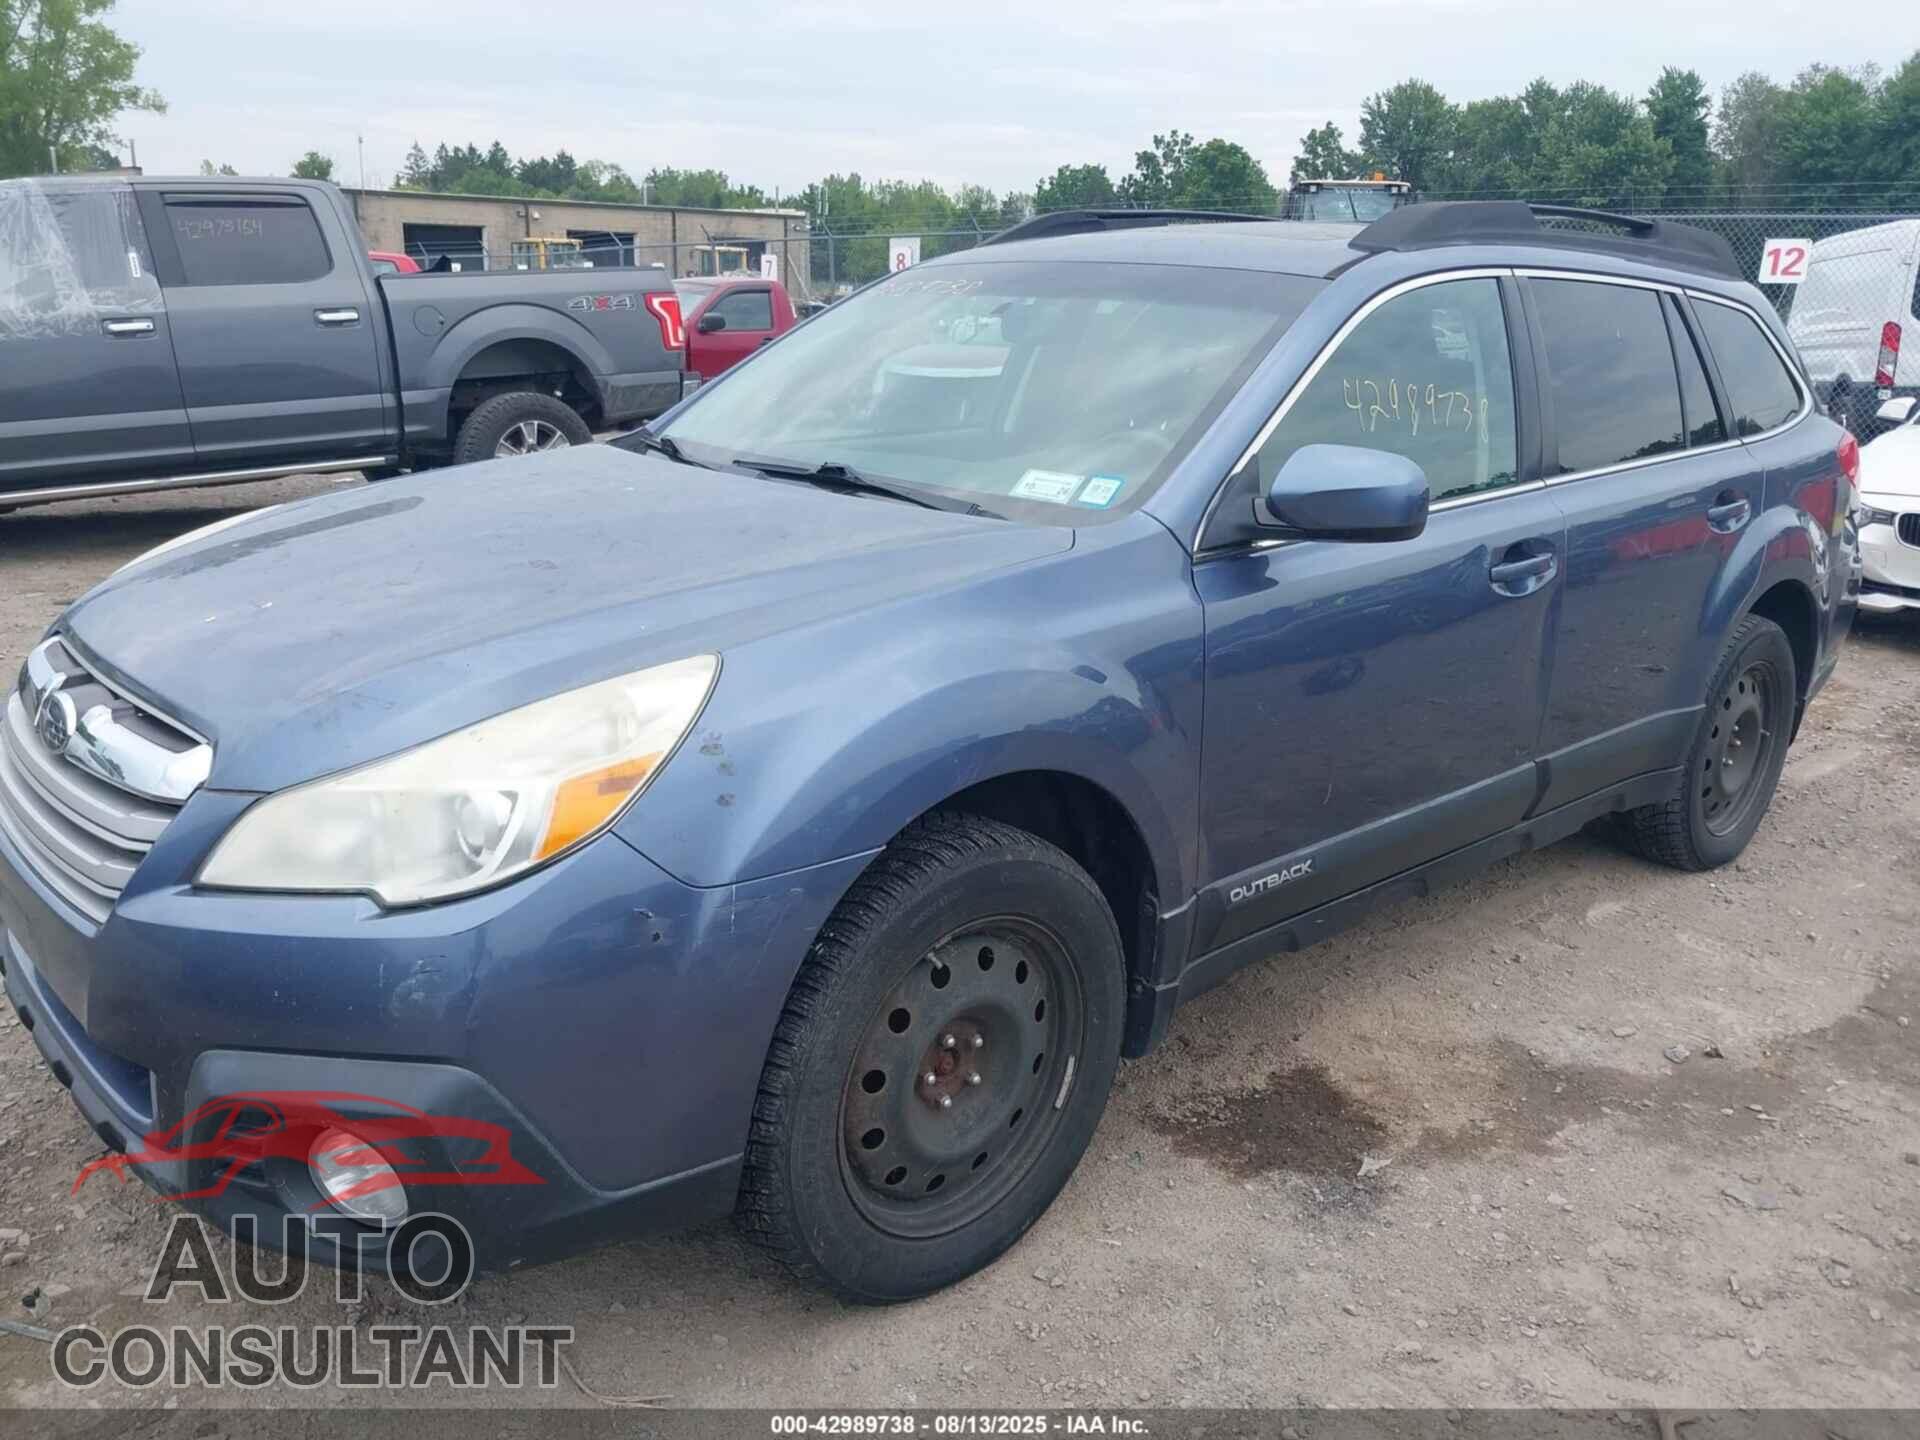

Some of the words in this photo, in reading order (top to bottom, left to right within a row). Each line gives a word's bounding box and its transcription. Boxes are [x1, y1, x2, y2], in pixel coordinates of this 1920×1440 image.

[764, 260, 773, 277] 7
[895, 252, 906, 272] 8
[1767, 246, 1806, 276] 12
[1343, 377, 1489, 444] 42989738
[1229, 858, 1313, 903] OUTBACK
